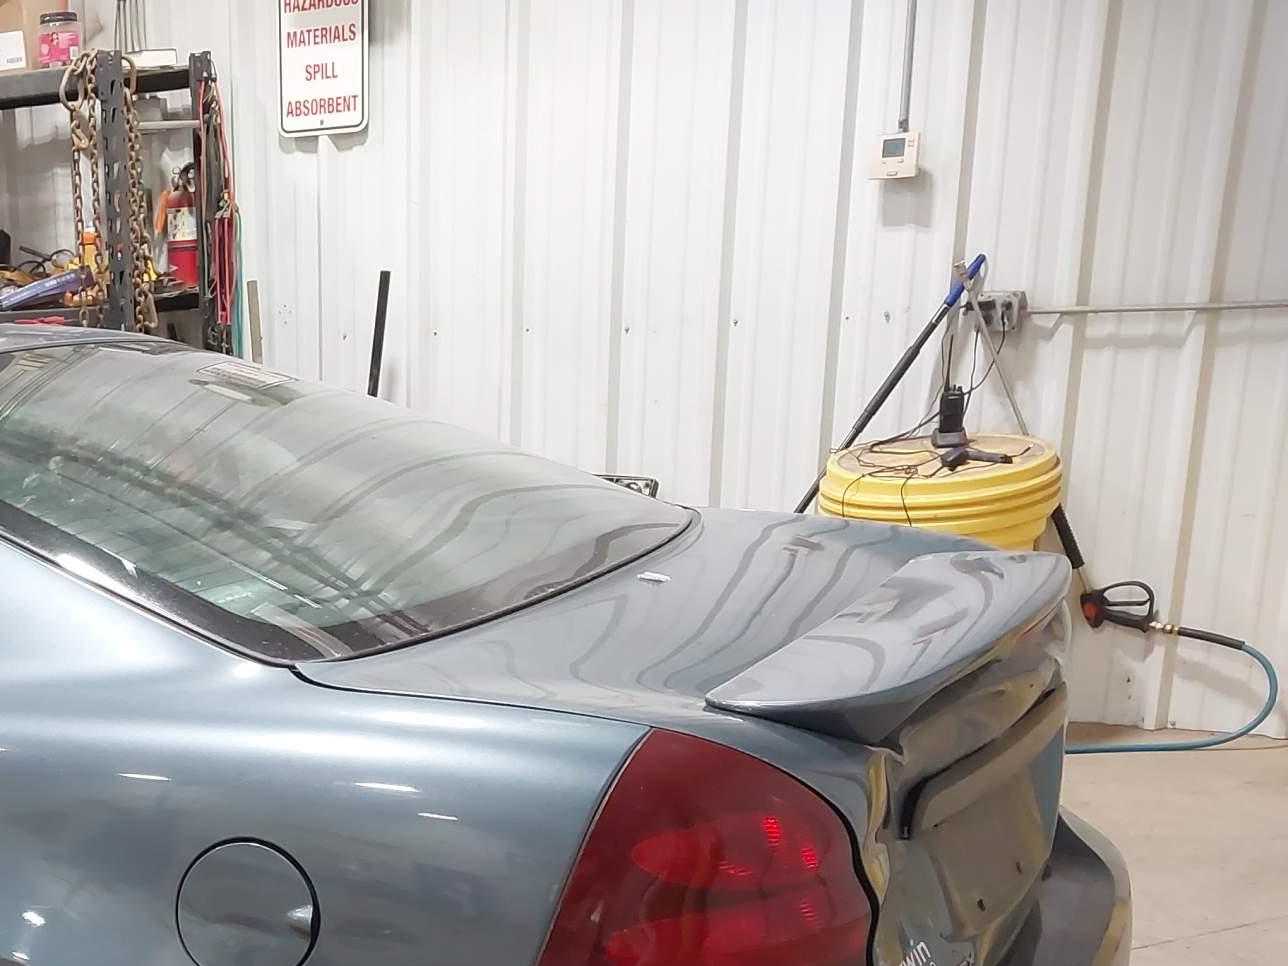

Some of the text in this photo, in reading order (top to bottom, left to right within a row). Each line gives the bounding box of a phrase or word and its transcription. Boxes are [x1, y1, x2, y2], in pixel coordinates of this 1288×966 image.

[286, 23, 357, 49] MATERIALS
[304, 61, 339, 82] SPILL
[286, 94, 359, 119] ABSORBENT
